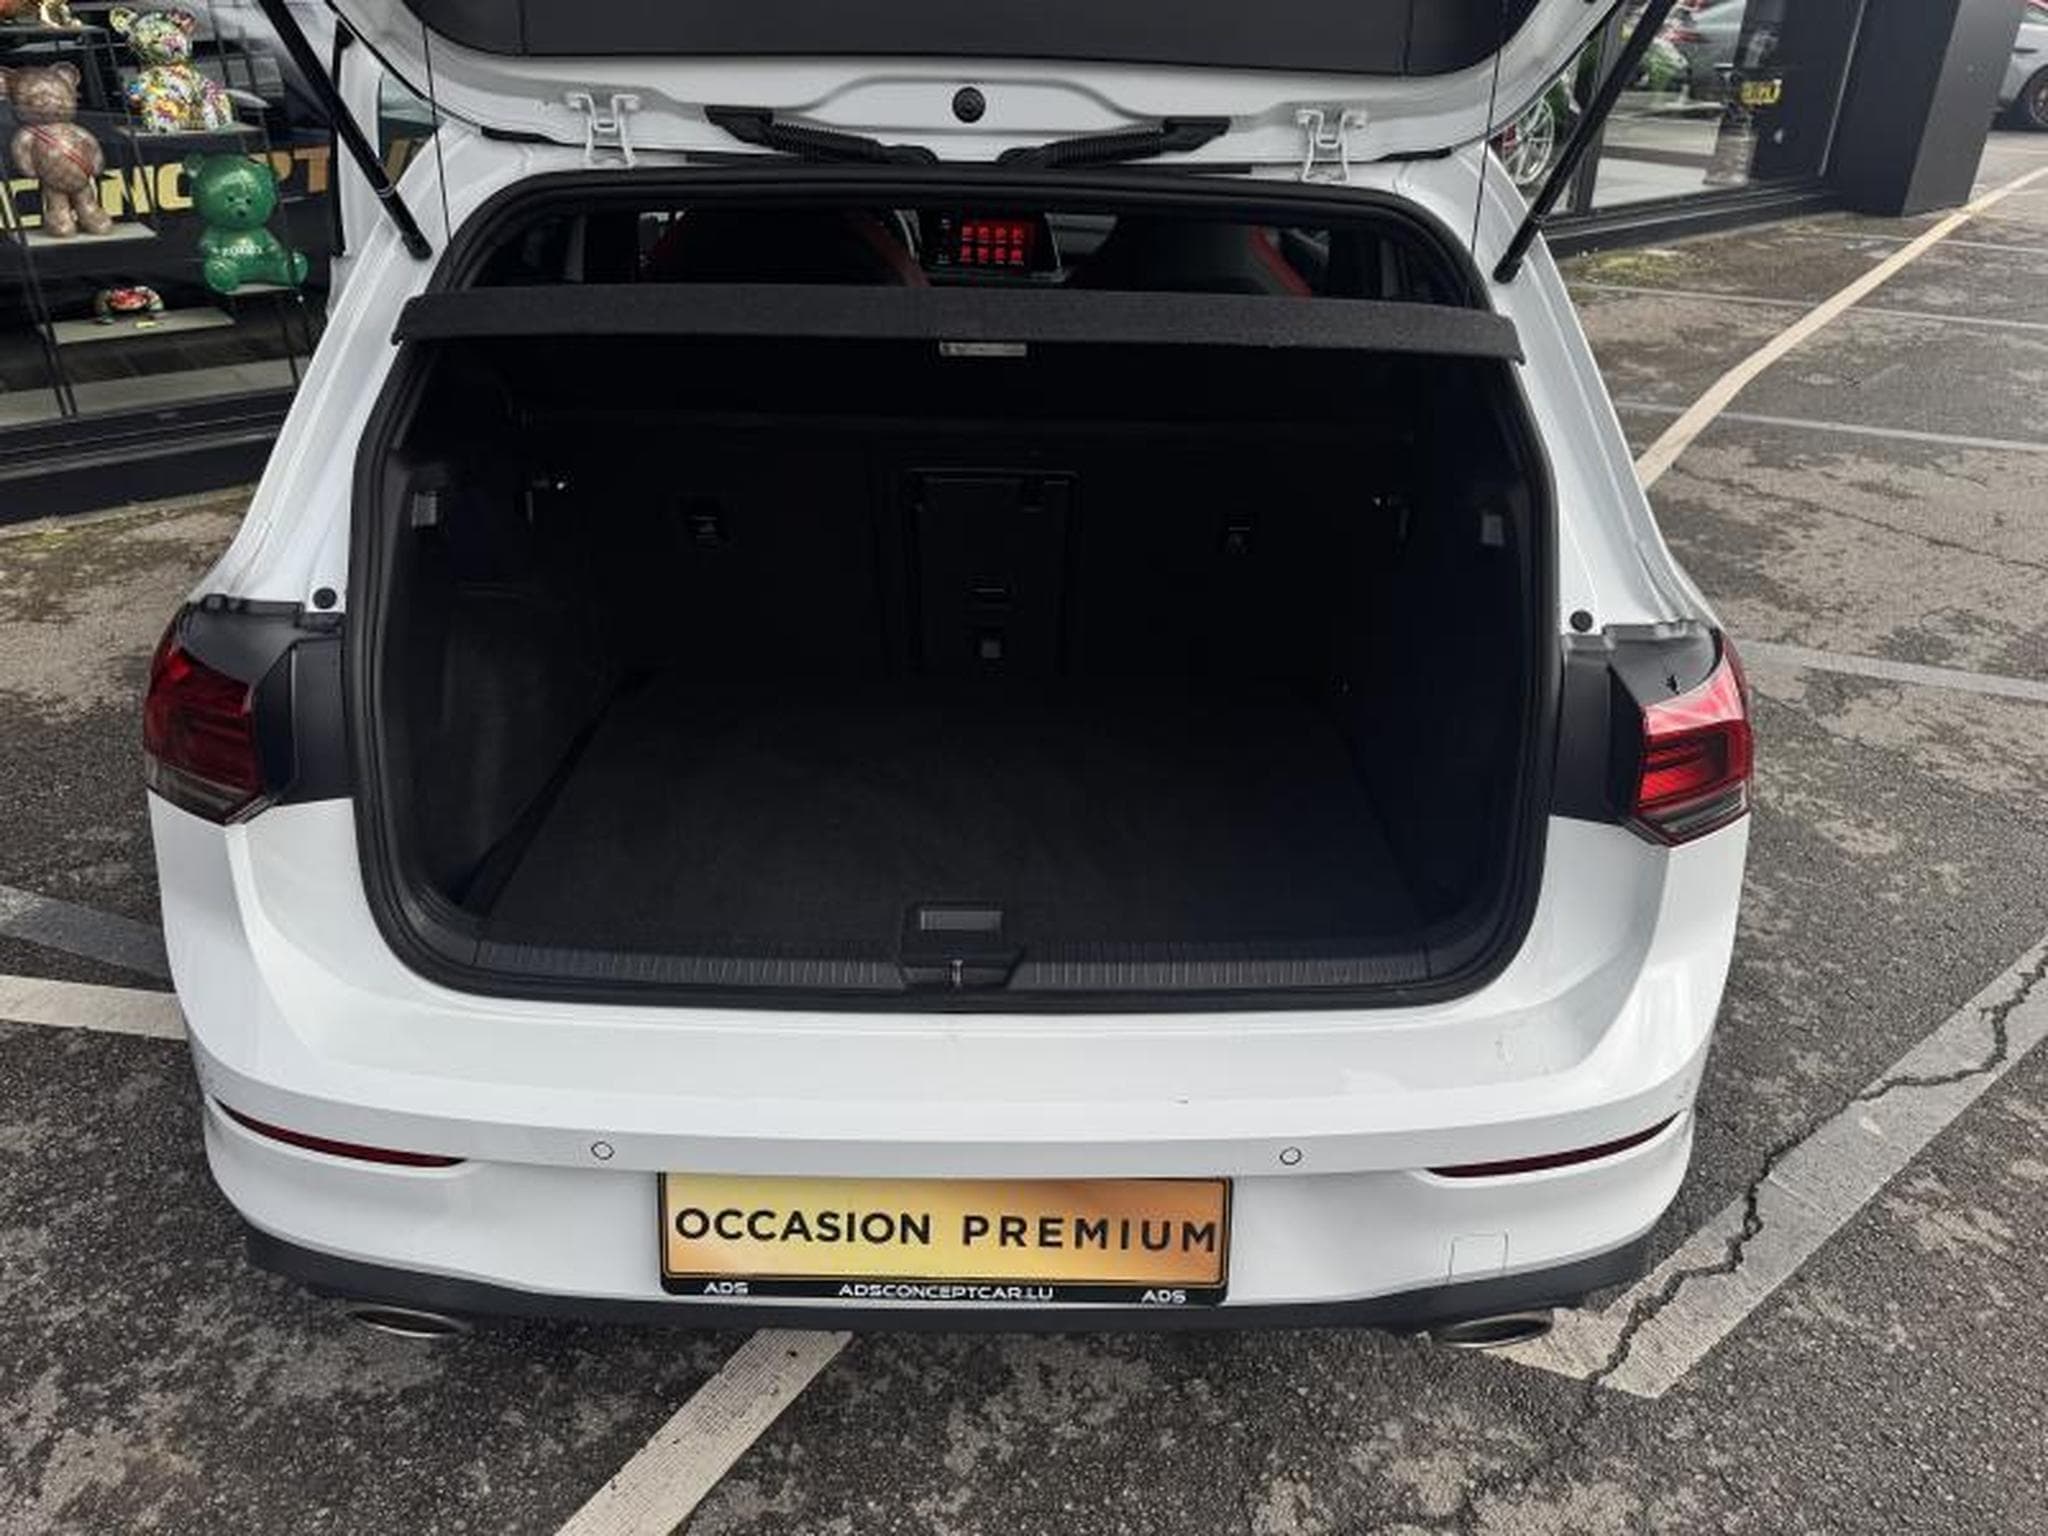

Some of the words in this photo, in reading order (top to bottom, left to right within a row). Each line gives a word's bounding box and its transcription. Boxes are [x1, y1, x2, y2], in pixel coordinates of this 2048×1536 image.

[0, 146, 330, 229] CNCPT
[675, 1207, 931, 1245] OCCASION
[962, 1214, 1217, 1253] PREMIUM
[703, 1281, 749, 1295] ADS
[838, 1283, 1054, 1300] ADSCONCEPTCAR.LU
[1141, 1289, 1187, 1304] ADS
